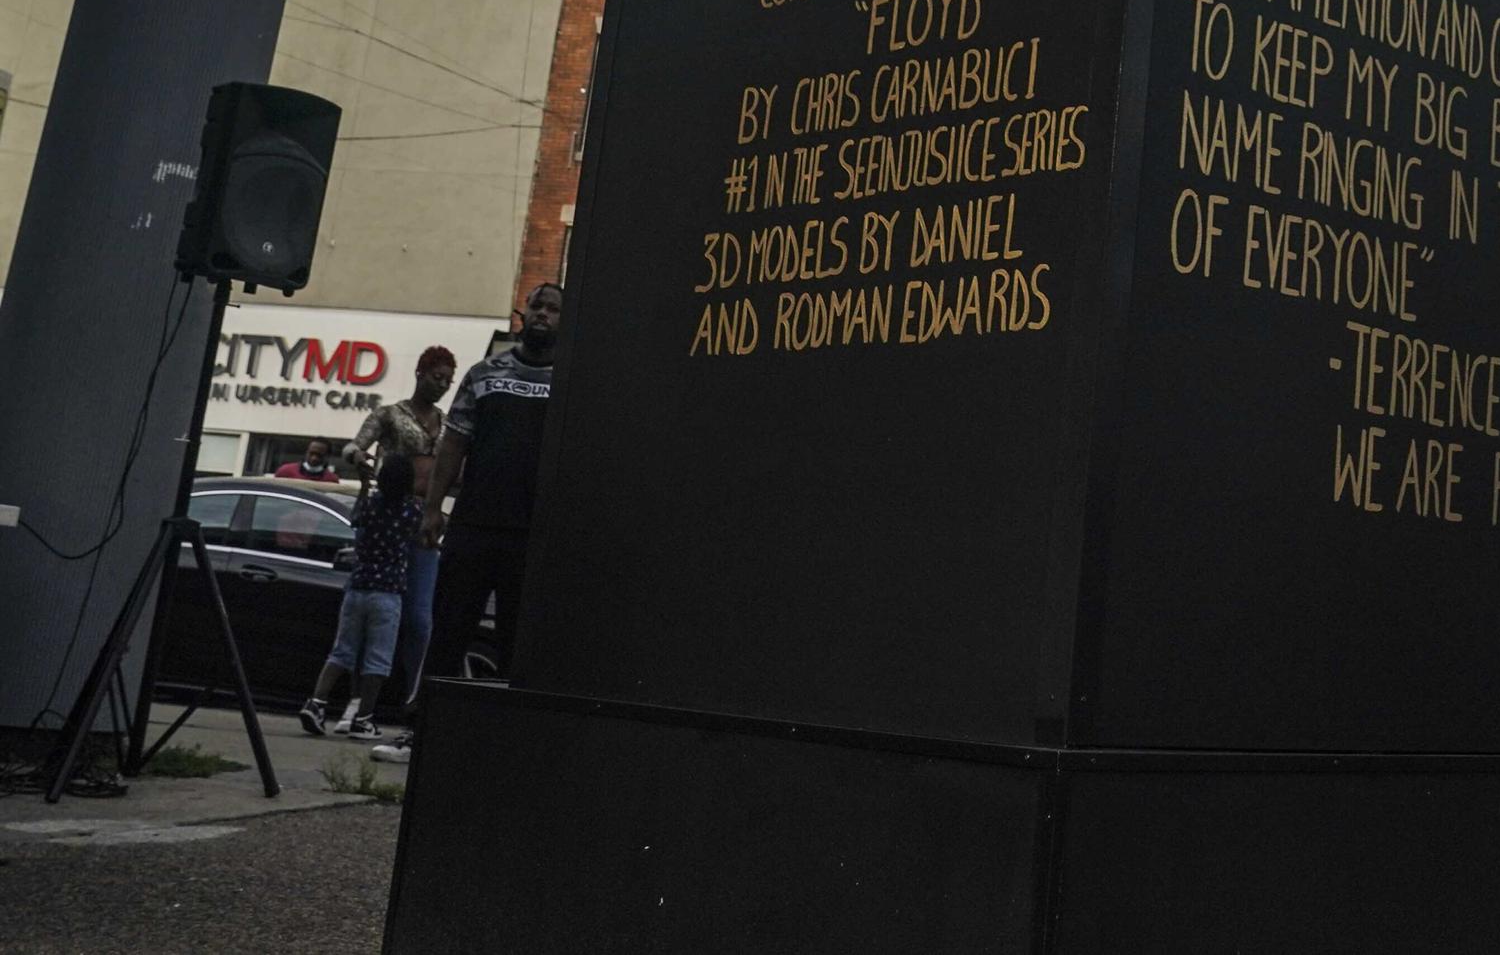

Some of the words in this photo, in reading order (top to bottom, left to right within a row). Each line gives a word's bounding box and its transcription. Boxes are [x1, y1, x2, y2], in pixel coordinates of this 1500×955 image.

[738, 84, 778, 144] BY
[791, 69, 861, 135] CHRIS
[871, 38, 1040, 123] CARNABUCI
[1252, 14, 1334, 108] KEEP
[1345, 48, 1399, 132] MY
[1414, 72, 1468, 160] BIG
[724, 154, 758, 214] #1
[764, 151, 788, 209] IN
[793, 144, 829, 205] THE
[1001, 105, 1089, 177] SERIES
[1179, 89, 1284, 194] NAME
[1297, 121, 1423, 230] RINGING
[1449, 169, 1479, 244] IN
[695, 232, 742, 293] 3D
[746, 215, 849, 286] MODELS
[859, 210, 901, 274] BY
[910, 193, 1023, 268] DANIEL
[1171, 188, 1230, 278] OF
[690, 298, 759, 357] AND
[774, 284, 894, 351] RODMAN
[899, 263, 1051, 344] EDWARDS
[235, 385, 321, 408] URGENT
[1333, 424, 1387, 513] WE
[1396, 437, 1464, 523] ARE
